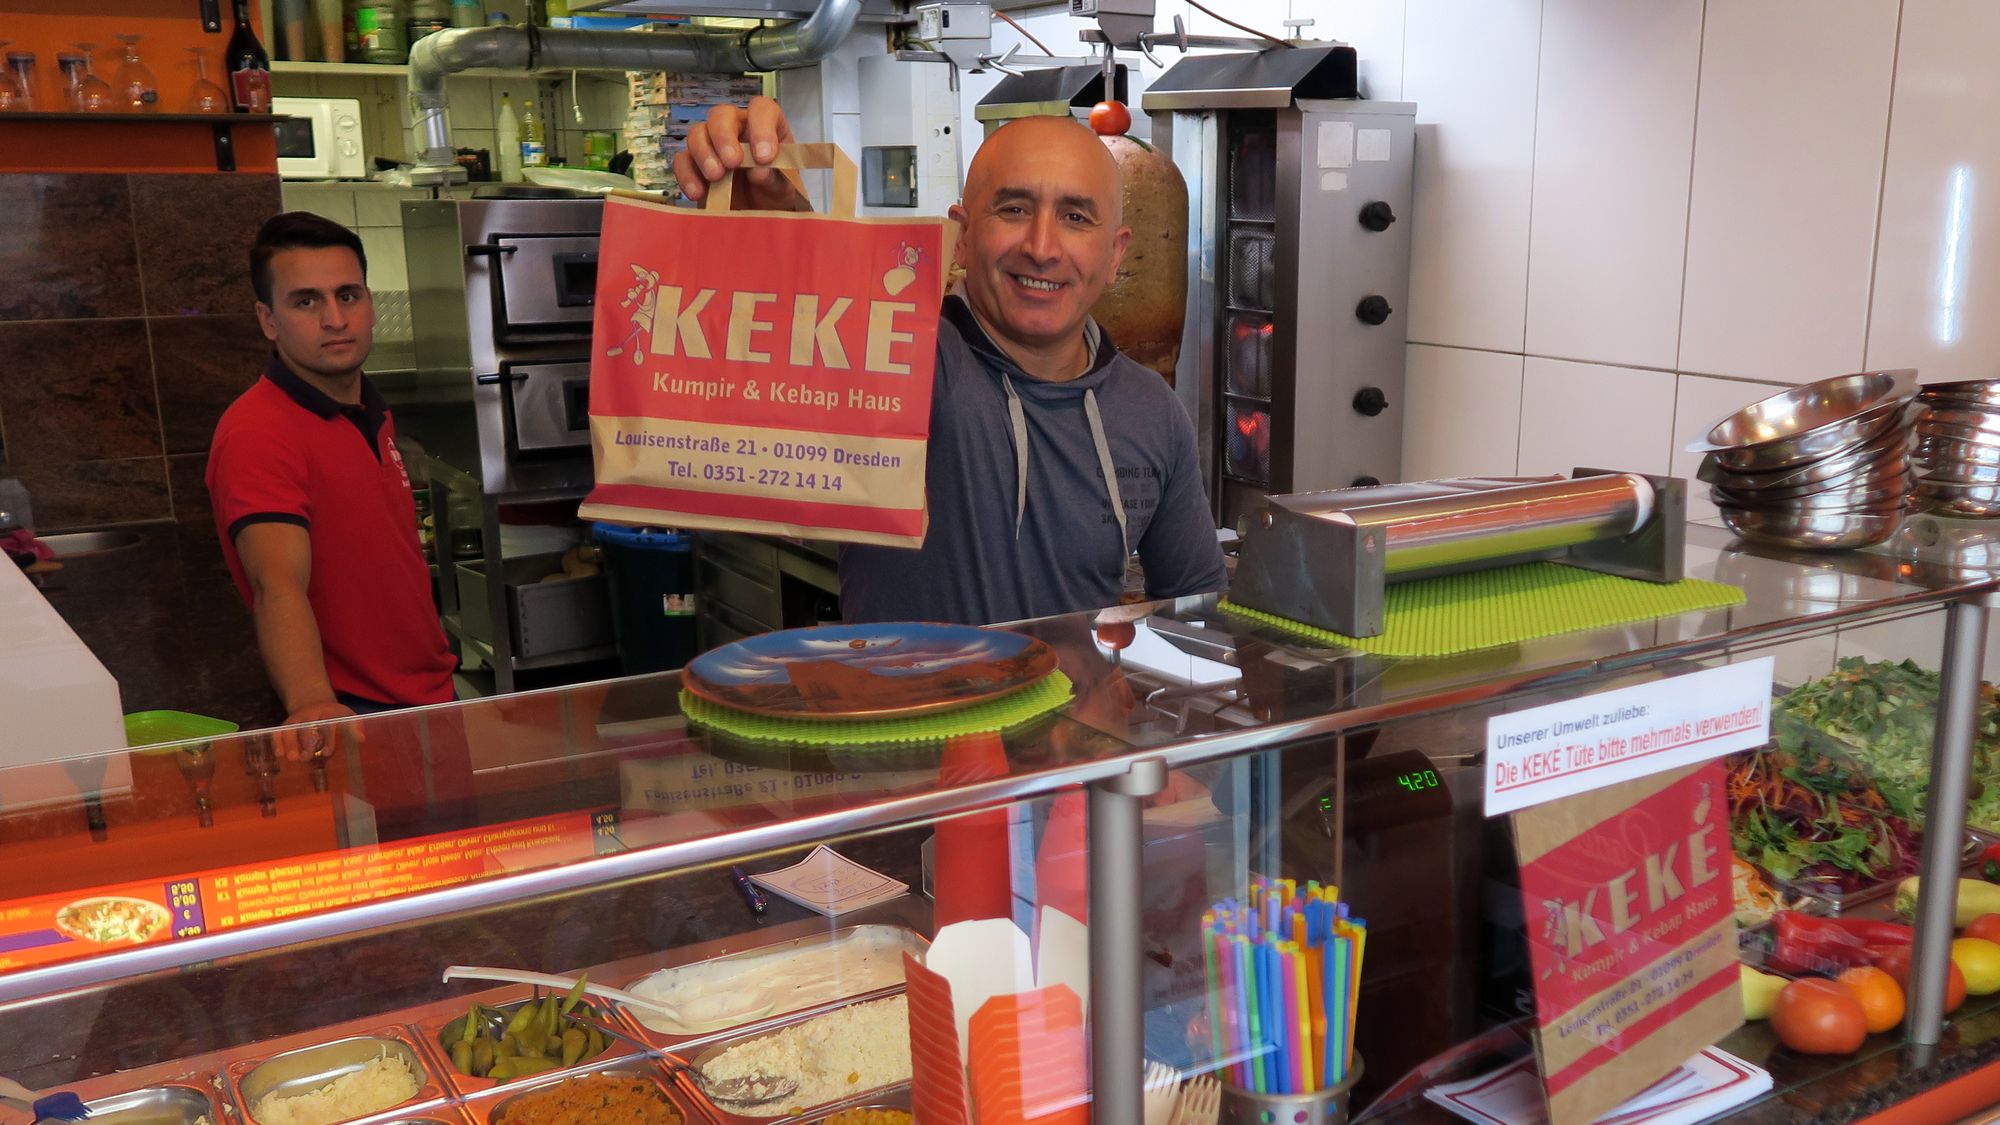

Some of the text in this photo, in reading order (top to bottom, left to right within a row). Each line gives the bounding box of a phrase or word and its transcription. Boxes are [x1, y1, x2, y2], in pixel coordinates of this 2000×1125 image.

[653, 371, 901, 412] Kumpir & Kebap Haus
[615, 430, 901, 468] Louisenstraße 21 01099 Dresden
[667, 461, 698, 479] Tel.
[794, 472, 816, 489] 14
[821, 474, 843, 491] 14
[1495, 701, 1763, 787] Die KEKÉ Tüte bitte mehrmals verwenden!
[1497, 704, 1650, 750] Unserer Umwelt zuliebe:
[1396, 770, 1440, 791] 4.20
